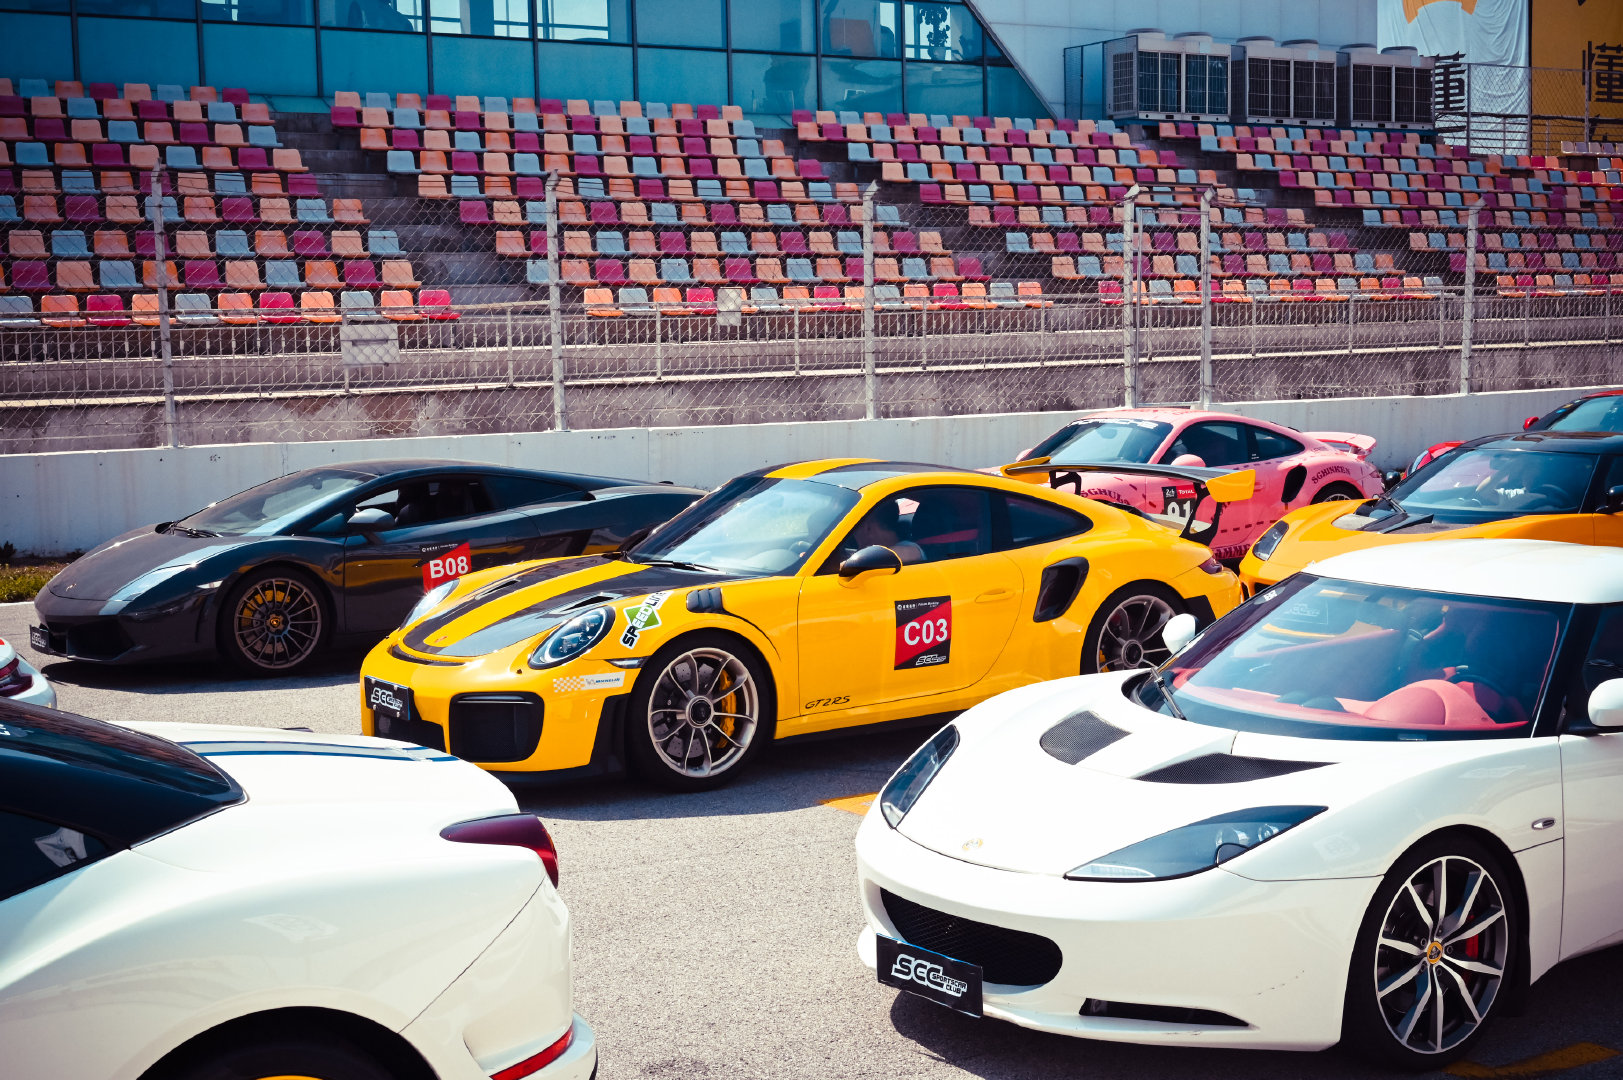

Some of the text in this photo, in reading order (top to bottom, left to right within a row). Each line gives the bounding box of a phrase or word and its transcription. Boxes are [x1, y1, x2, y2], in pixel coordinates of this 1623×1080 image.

[429, 555, 469, 579] B08
[904, 618, 948, 646] C03
[931, 973, 968, 990] SPORTSCAR
[945, 984, 963, 995] CLUB
